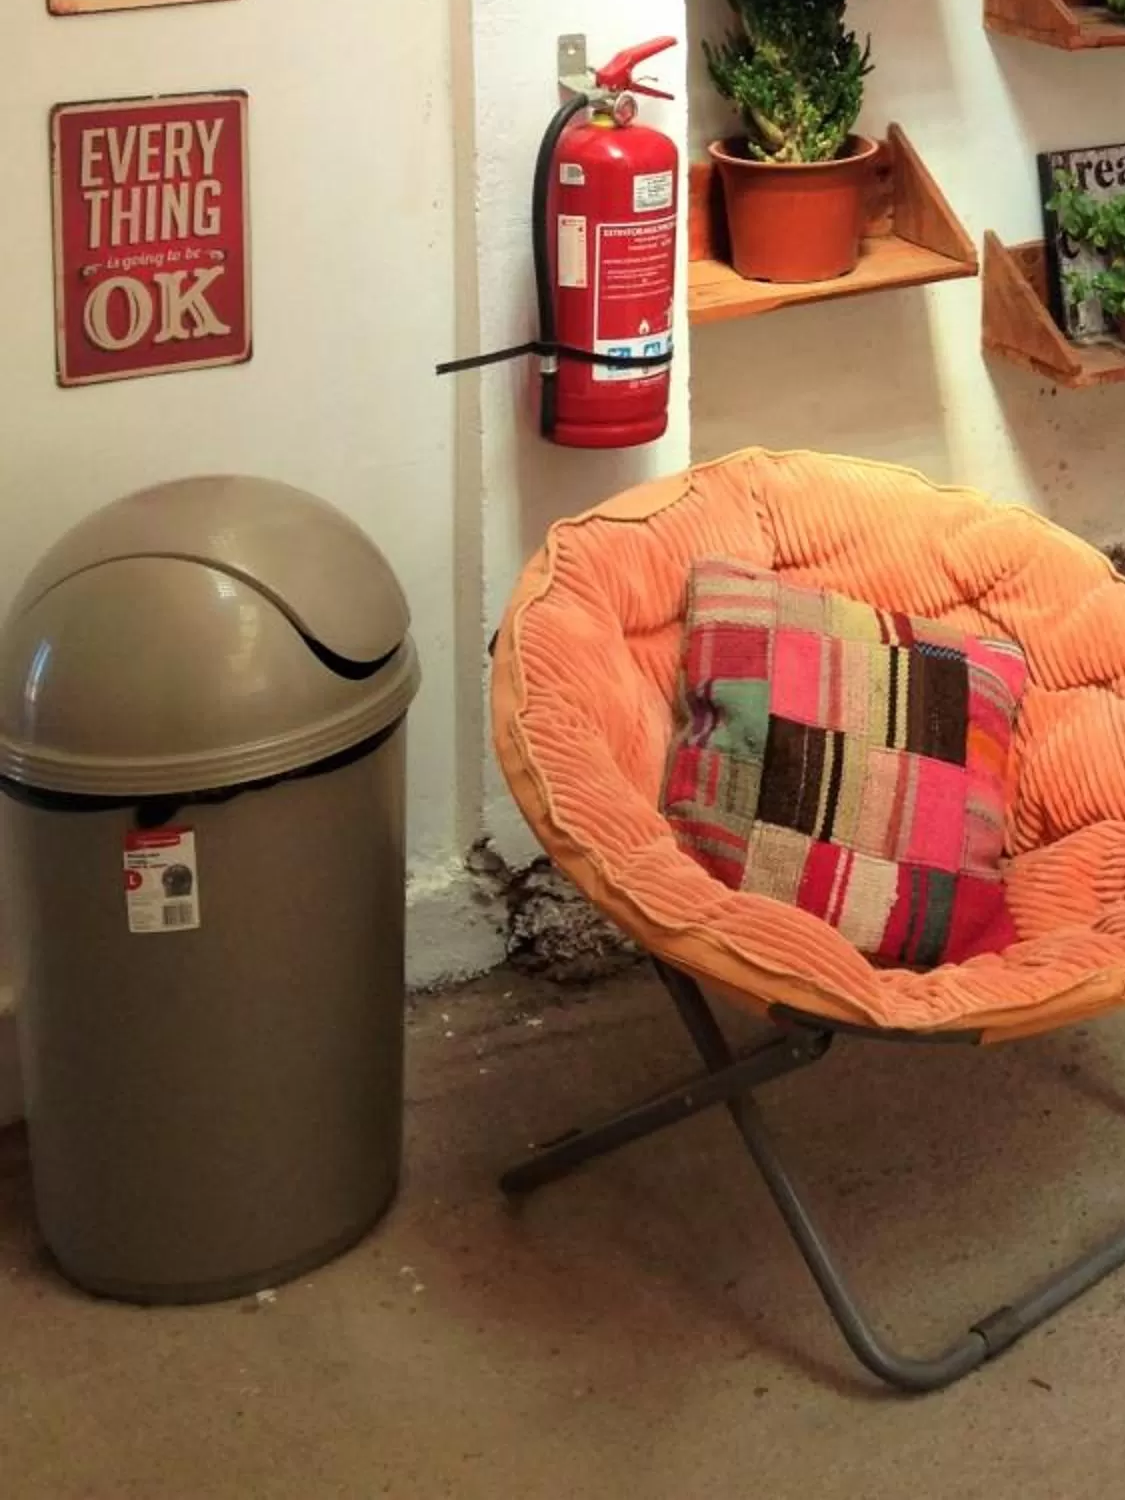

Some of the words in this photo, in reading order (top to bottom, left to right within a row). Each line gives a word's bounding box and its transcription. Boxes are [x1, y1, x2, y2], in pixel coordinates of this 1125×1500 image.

[80, 118, 225, 188] EVERY
[83, 179, 222, 249] THING
[121, 251, 165, 271] going
[166, 248, 181, 261] to
[83, 265, 232, 351] OK
